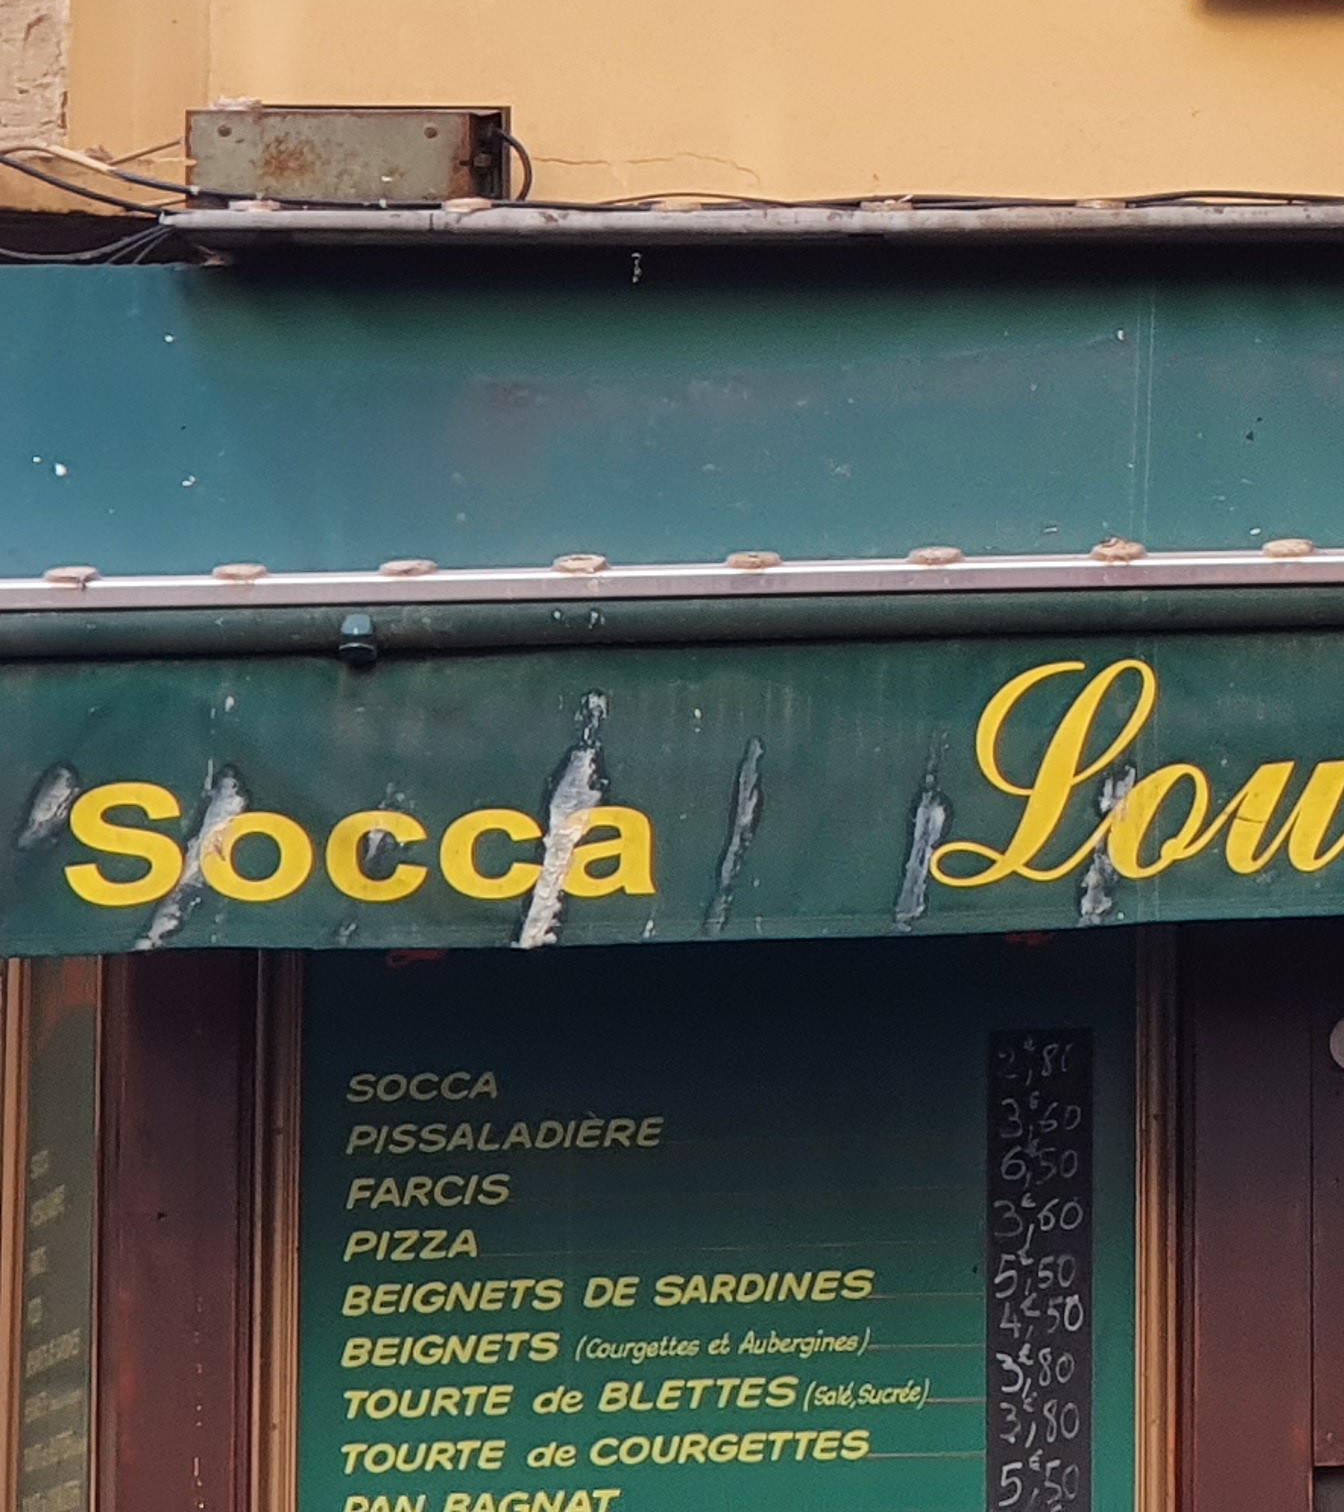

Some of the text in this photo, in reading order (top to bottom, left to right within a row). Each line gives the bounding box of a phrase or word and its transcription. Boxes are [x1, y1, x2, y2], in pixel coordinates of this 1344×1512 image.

[64, 780, 657, 906] Socca
[346, 1071, 499, 1103] SOCCA
[346, 1110, 664, 1155] PISSALADIÈRE
[346, 1173, 511, 1209] FARCIS
[343, 1229, 478, 1262] PIZZA
[342, 1269, 875, 1316] BEIGNETS DE SARDINES
[341, 1327, 870, 1368] BEIGNETS (Courgettes et Aubergines)
[343, 1384, 514, 1419] TOURTE
[532, 1385, 583, 1413] de
[598, 1376, 799, 1412] BLETTES
[341, 1430, 870, 1475] TOURTE de COURGETTES
